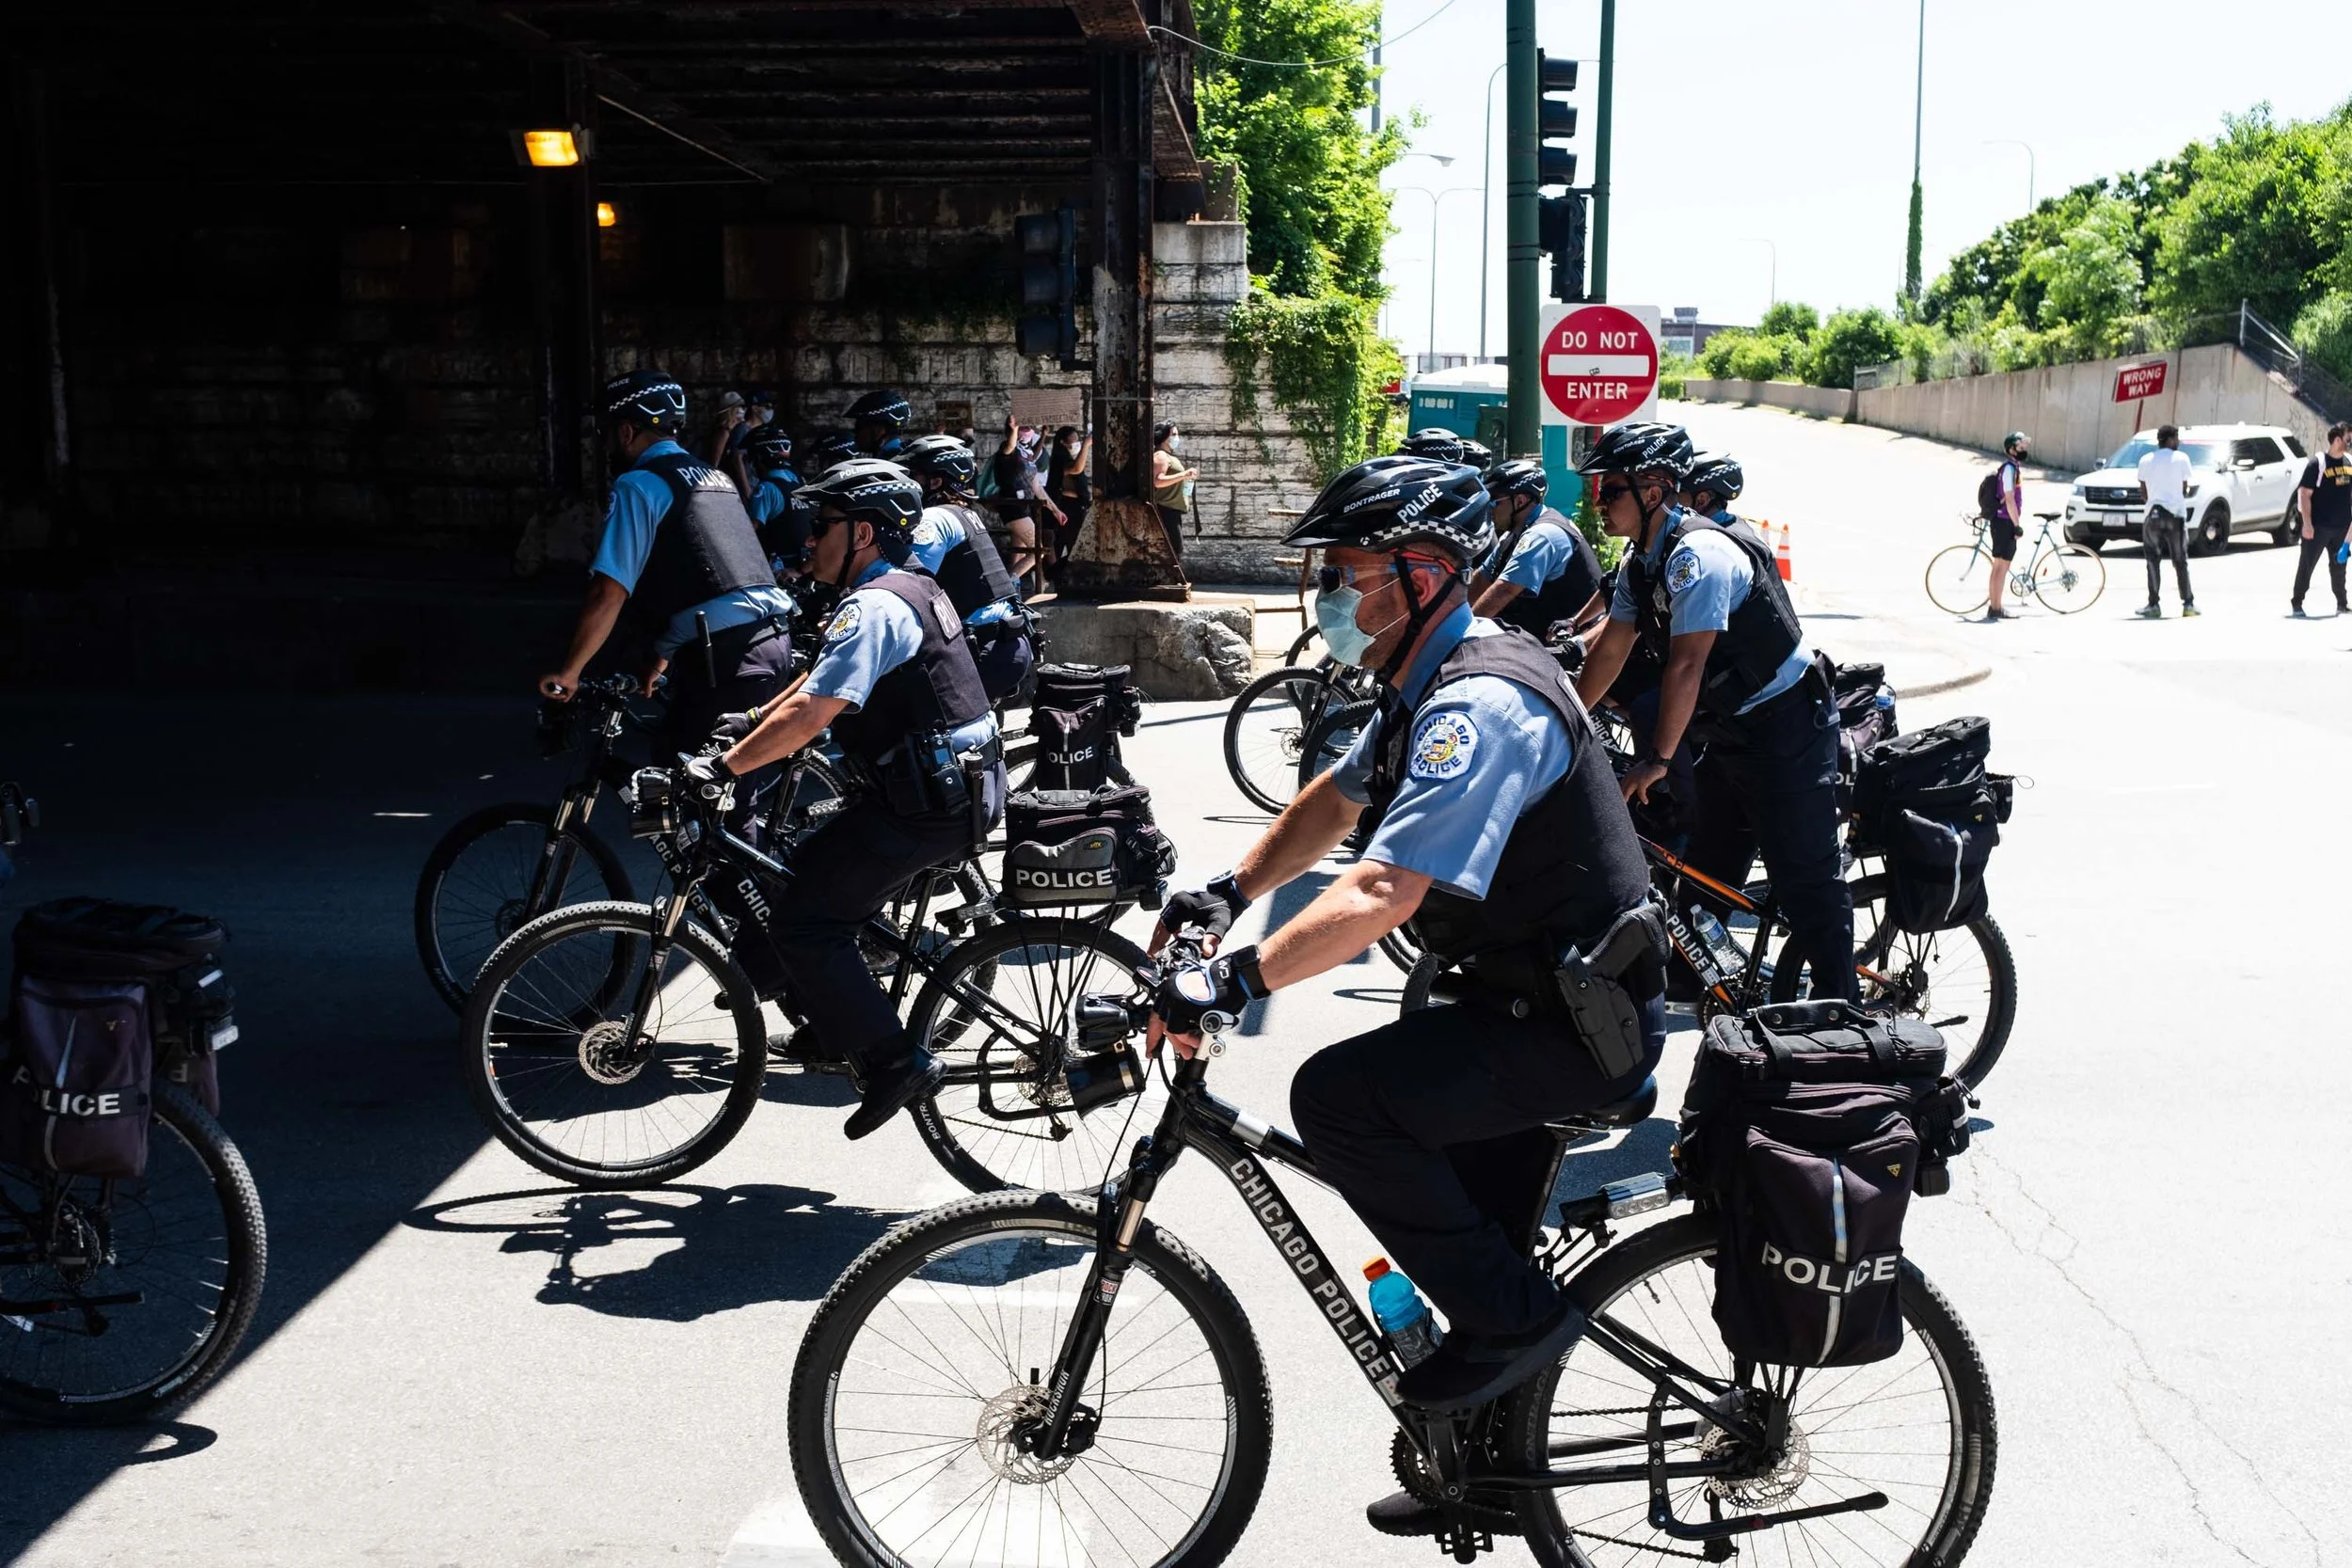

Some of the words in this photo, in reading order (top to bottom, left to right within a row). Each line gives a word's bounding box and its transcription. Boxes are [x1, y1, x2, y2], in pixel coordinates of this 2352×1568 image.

[1562, 331, 1587, 349] DO
[1599, 332, 1638, 349] NOT
[2123, 367, 2162, 385] WRONG
[1566, 382, 1629, 399] ENTER
[2128, 381, 2152, 397] WAY
[1642, 436, 1667, 459] POLICE
[676, 467, 733, 488] POLICE
[839, 466, 870, 479] POLICE
[1343, 488, 1401, 514] BONTRAGER
[1397, 483, 1443, 523] POLICE
[1417, 716, 1470, 745] CHICAGO
[1048, 746, 1093, 765] OLICE
[1414, 753, 1462, 774] POLICE
[1016, 867, 1113, 888] POLICE
[738, 879, 771, 931] CHIC
[1666, 913, 1709, 971] POLICE
[13, 1065, 120, 1117] PLICE
[919, 1102, 941, 1140] BONTR
[1230, 1158, 1319, 1275] CHICAGO
[1312, 1278, 1391, 1379] POLICE
[1761, 1241, 1898, 1294] POLICE
